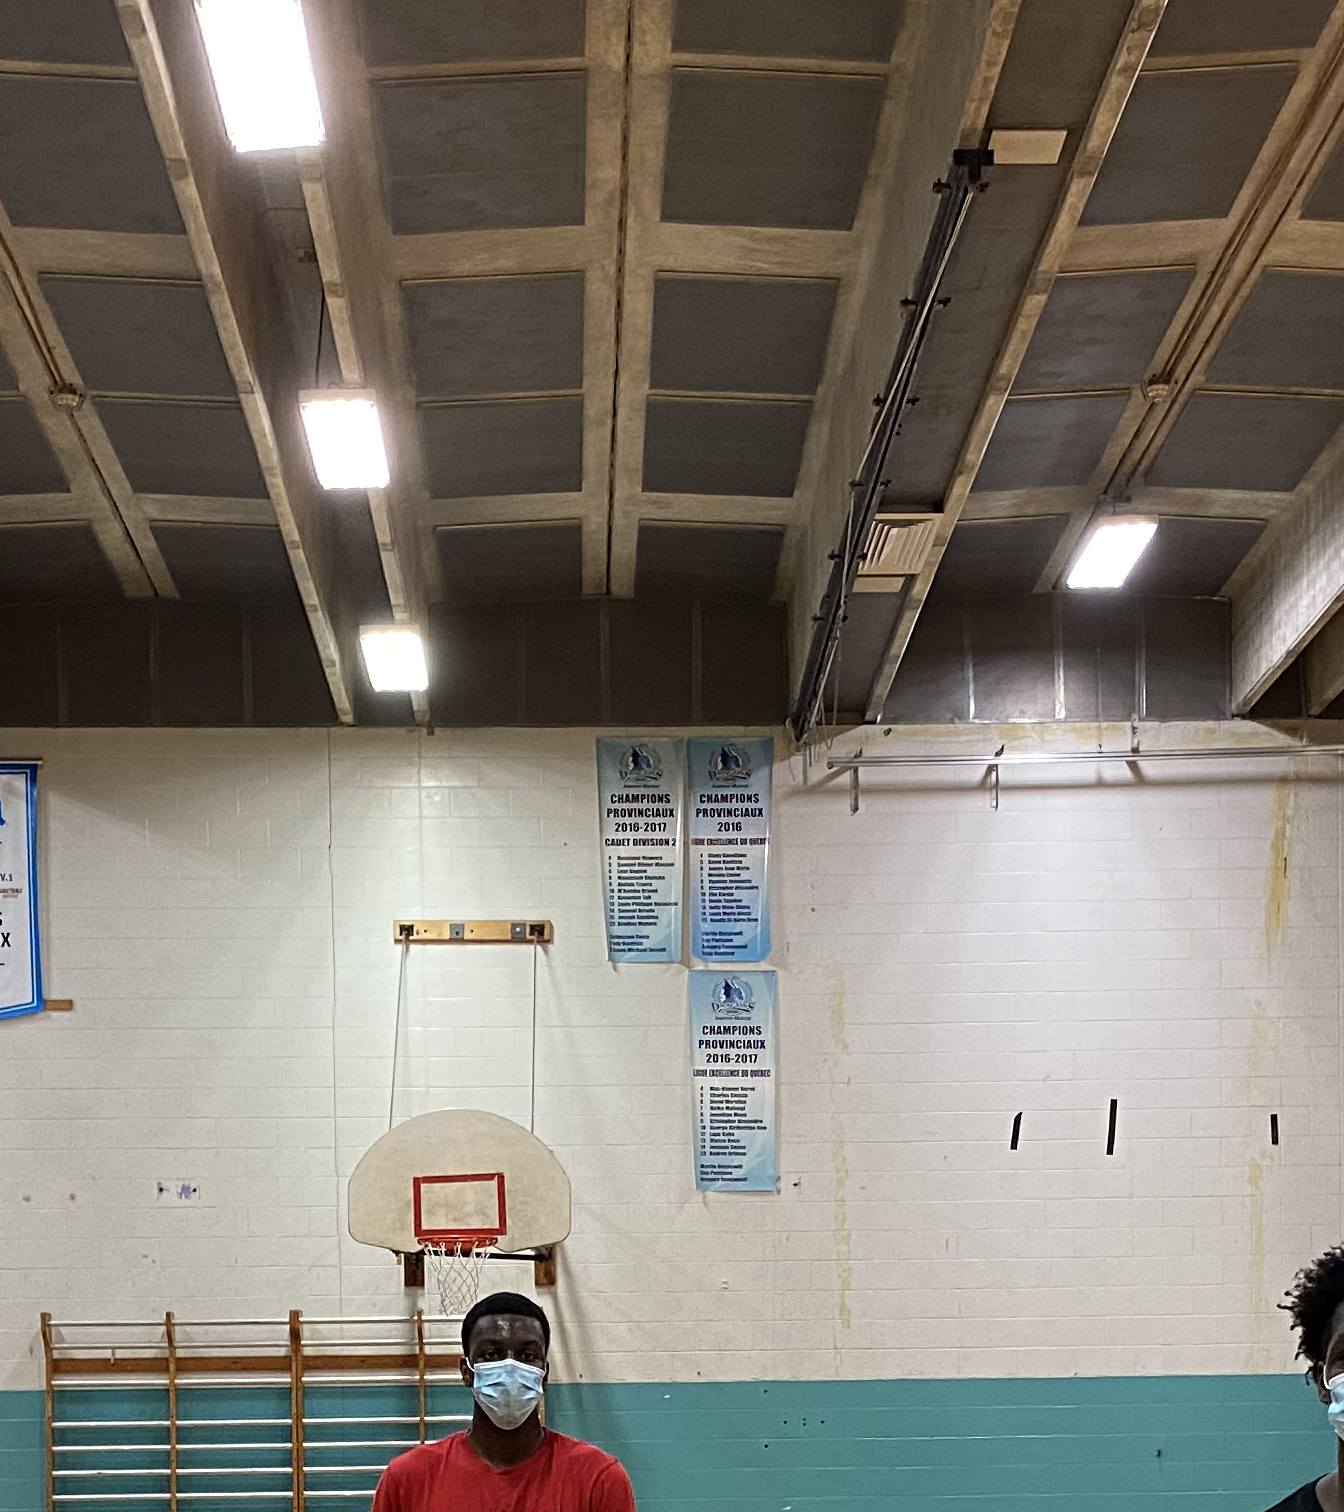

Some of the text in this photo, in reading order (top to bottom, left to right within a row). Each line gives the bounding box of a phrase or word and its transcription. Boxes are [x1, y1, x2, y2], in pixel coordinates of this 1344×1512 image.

[611, 793, 671, 804] CHAMPIONS
[699, 793, 760, 804] CHAMPIONS
[607, 807, 675, 818] PROVINCIAUX
[696, 807, 764, 818] PROVINCIAUX
[614, 822, 667, 832] 2016-2017
[717, 821, 743, 832] 2016
[605, 838, 677, 847] CADET DIVISION 2
[702, 1025, 762, 1036] CHAMPIONS
[698, 1039, 766, 1050] PROVINCIAUX
[706, 1053, 758, 1064] 2016-2017
